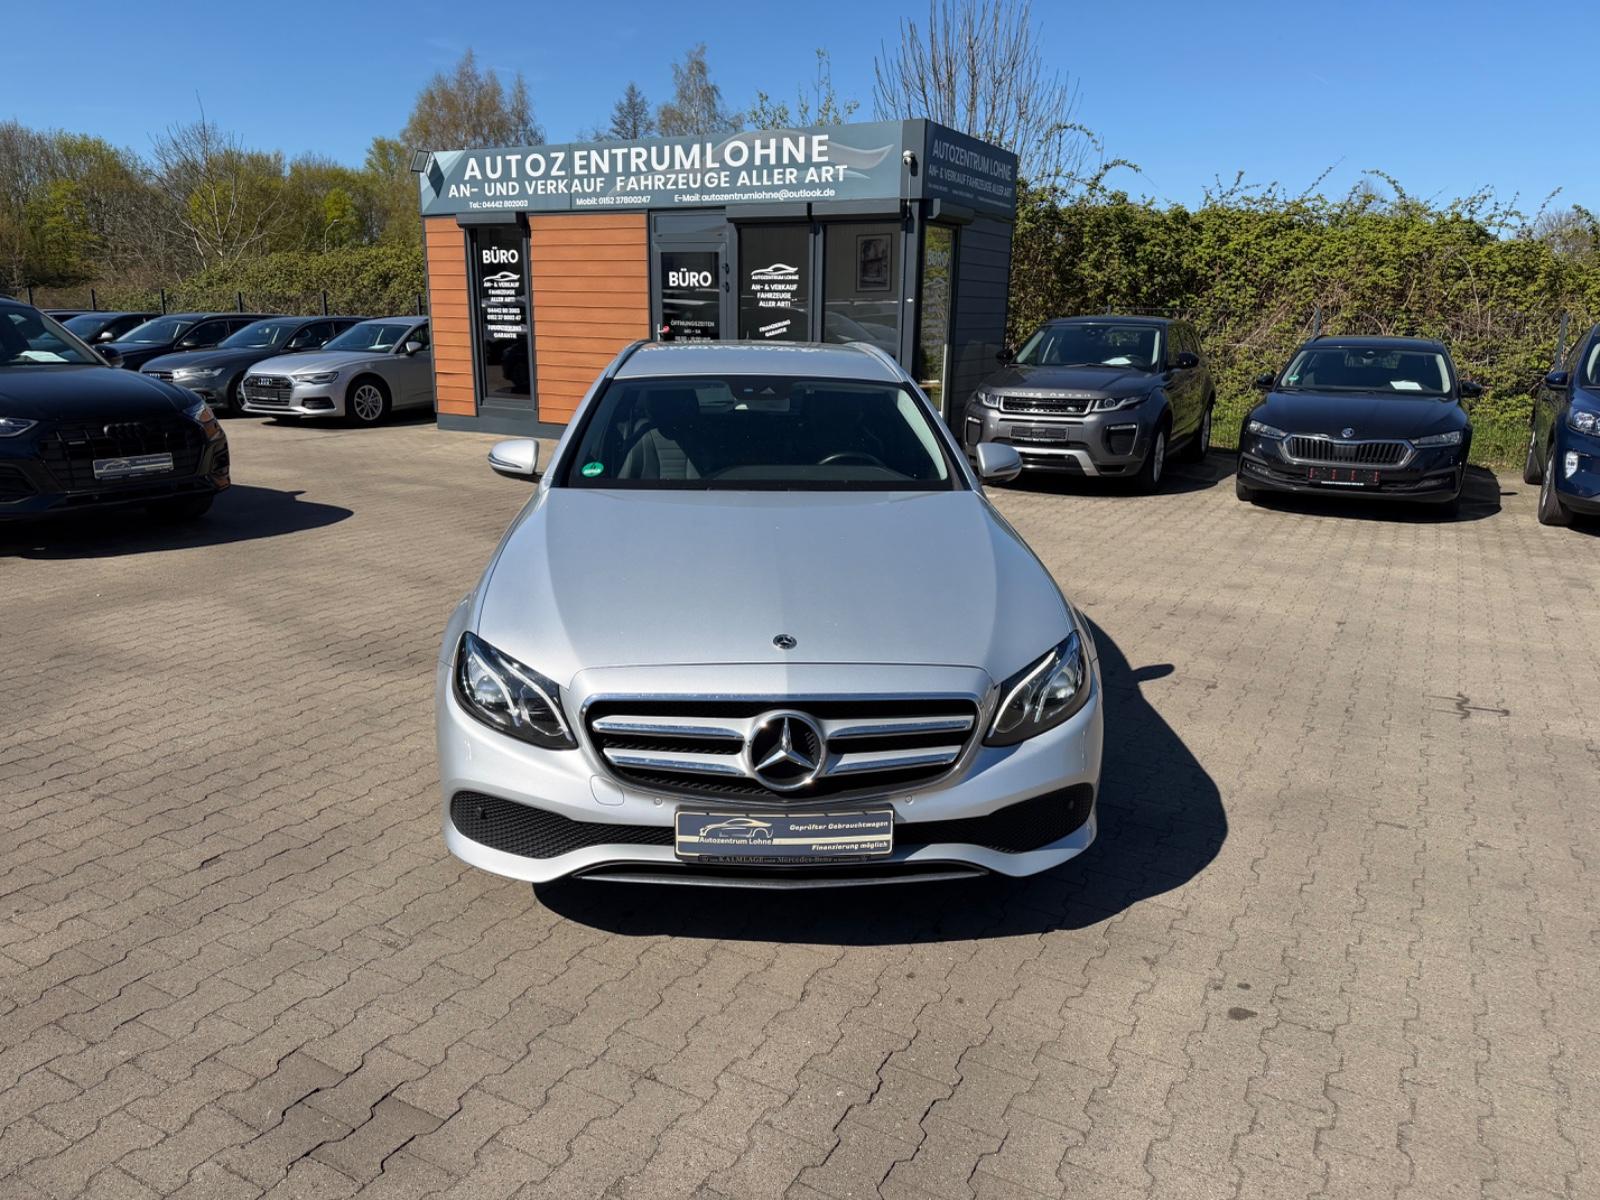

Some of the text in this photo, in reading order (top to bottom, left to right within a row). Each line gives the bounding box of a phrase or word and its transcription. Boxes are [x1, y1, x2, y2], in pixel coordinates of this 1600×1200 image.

[932, 139, 1012, 181] AUTOZENTRUM LOHNE
[448, 164, 848, 198] AN- UND VERKAUF FAHRZEUGE ALLER ART
[576, 197, 598, 206] Mobil:
[482, 246, 519, 264] BÜRO
[668, 267, 712, 287] BÜRO
[770, 283, 798, 291] VERKAUF
[789, 820, 888, 832] Geprüfter Gebrauchtwagen
[700, 837, 772, 846] Autozentrum Lohne
[811, 840, 888, 851] Finanzierung möglich
